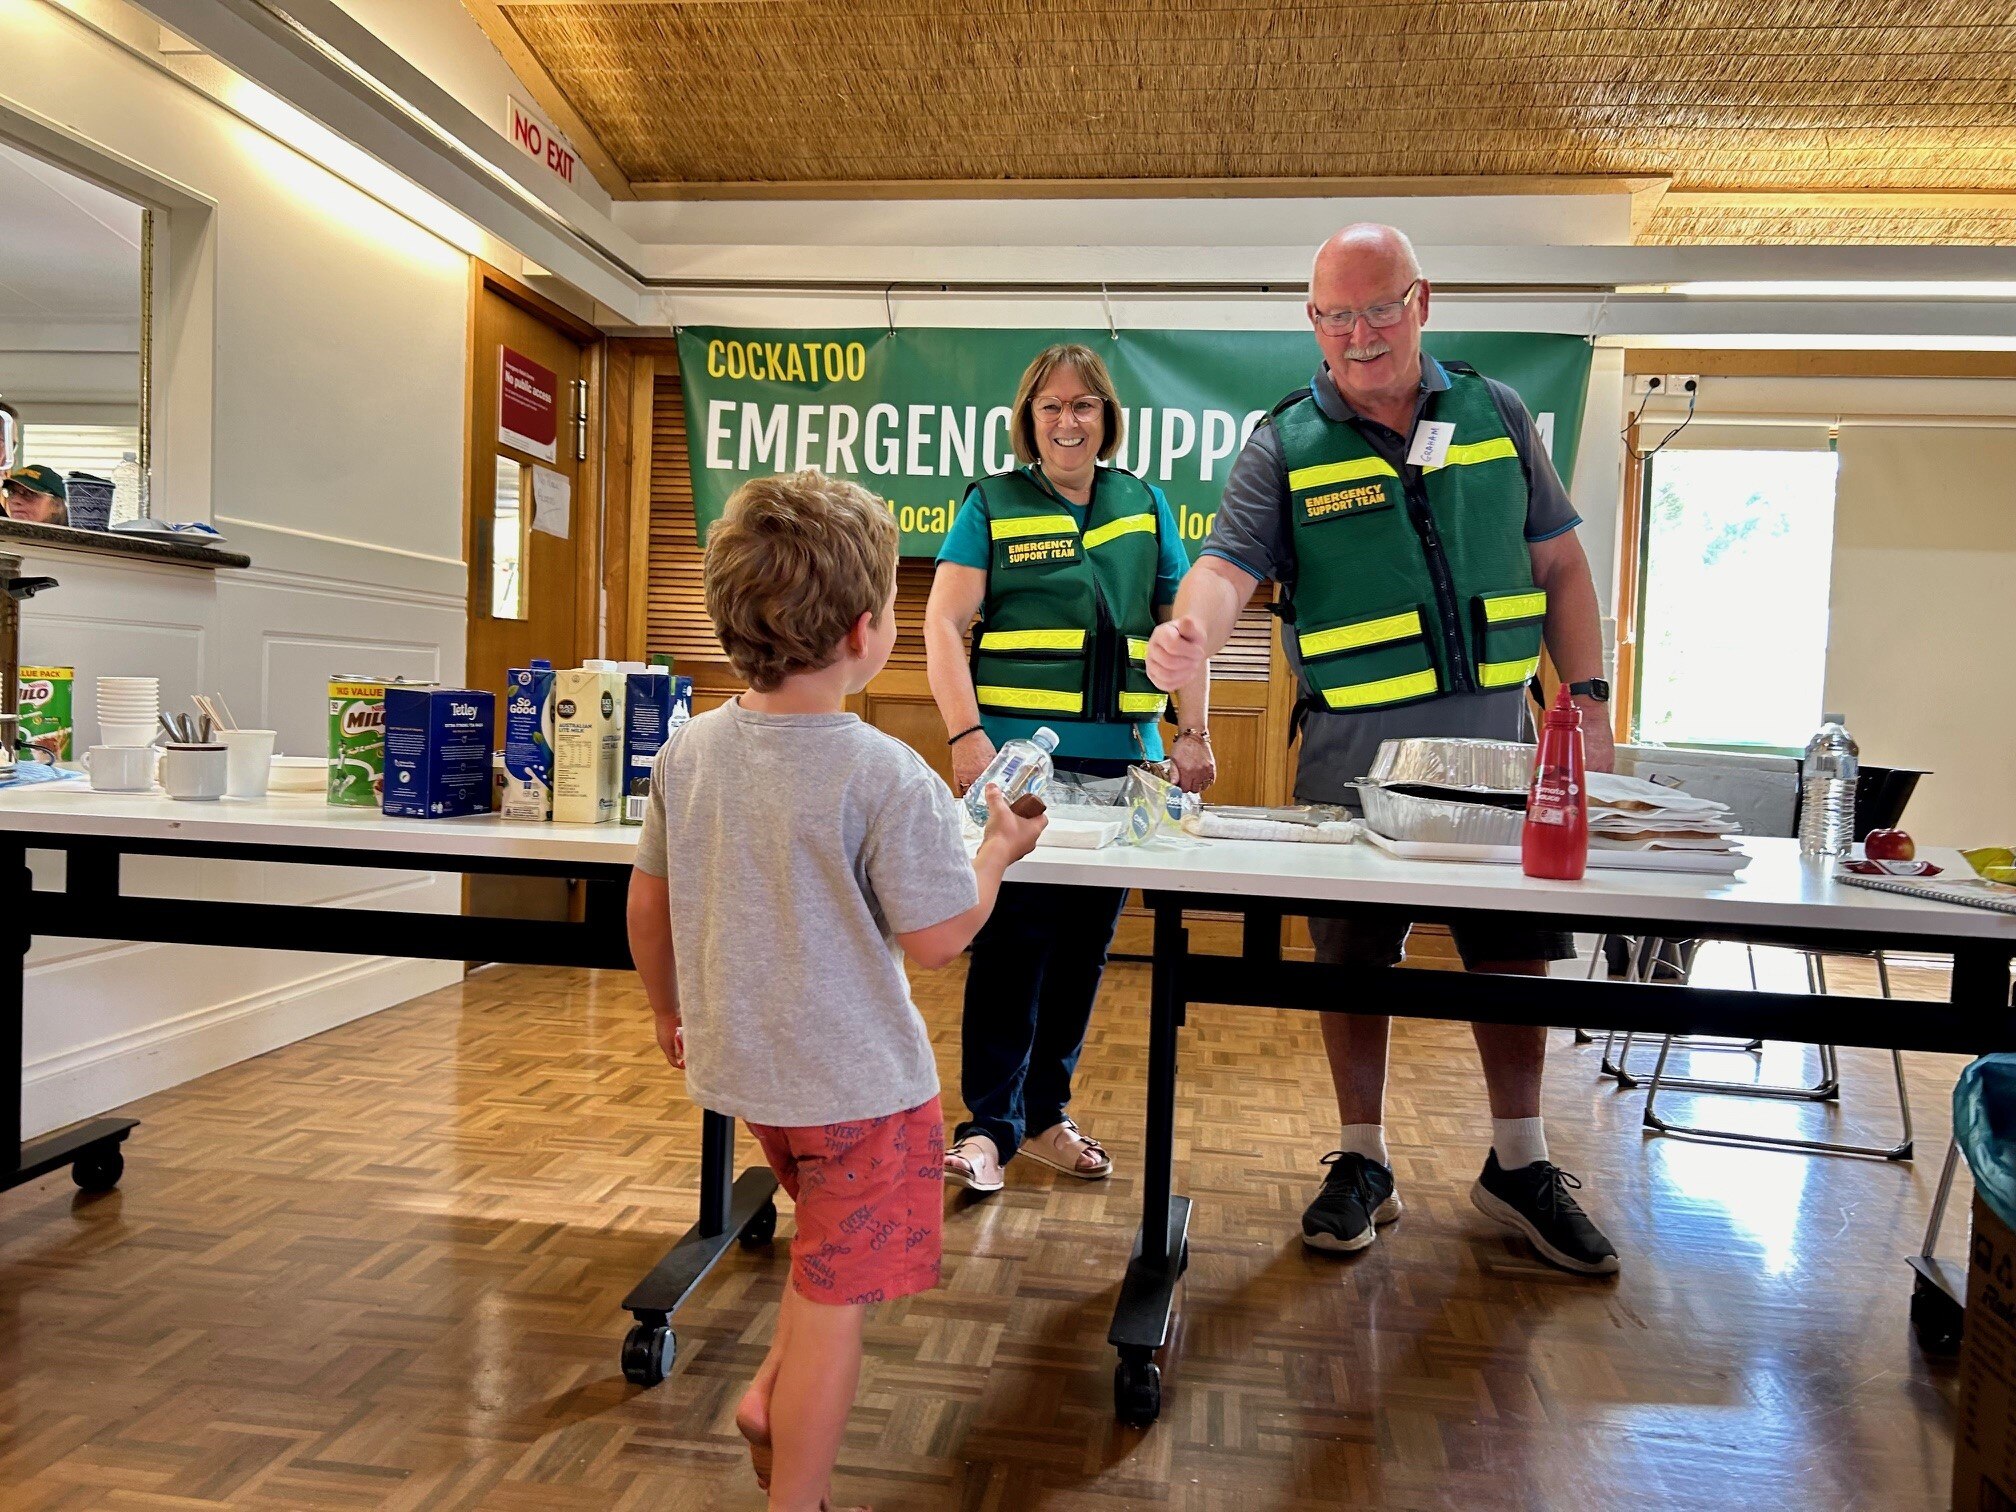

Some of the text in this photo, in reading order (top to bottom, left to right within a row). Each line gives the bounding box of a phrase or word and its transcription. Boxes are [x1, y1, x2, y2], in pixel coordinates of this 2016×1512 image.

[514, 108, 575, 184] NO EXIT
[707, 339, 867, 382] COCKATOO
[504, 369, 514, 386] No
[514, 377, 533, 395] public
[532, 386, 552, 404] access
[705, 399, 1016, 477] EMERGENC
[1420, 426, 1440, 463] GRAHAM
[1304, 483, 1383, 509] EMERGENCY
[1306, 492, 1386, 519] SUPPORT TEAM
[1008, 539, 1074, 555] EMERGENCY
[1009, 548, 1075, 564] SUPPORT TEAM
[40, 670, 61, 678] PACK
[350, 687, 384, 698] VALUE
[516, 697, 532, 707] So
[450, 702, 479, 721] Tetley
[509, 704, 537, 715] Good
[869, 1219, 902, 1252] COOL
